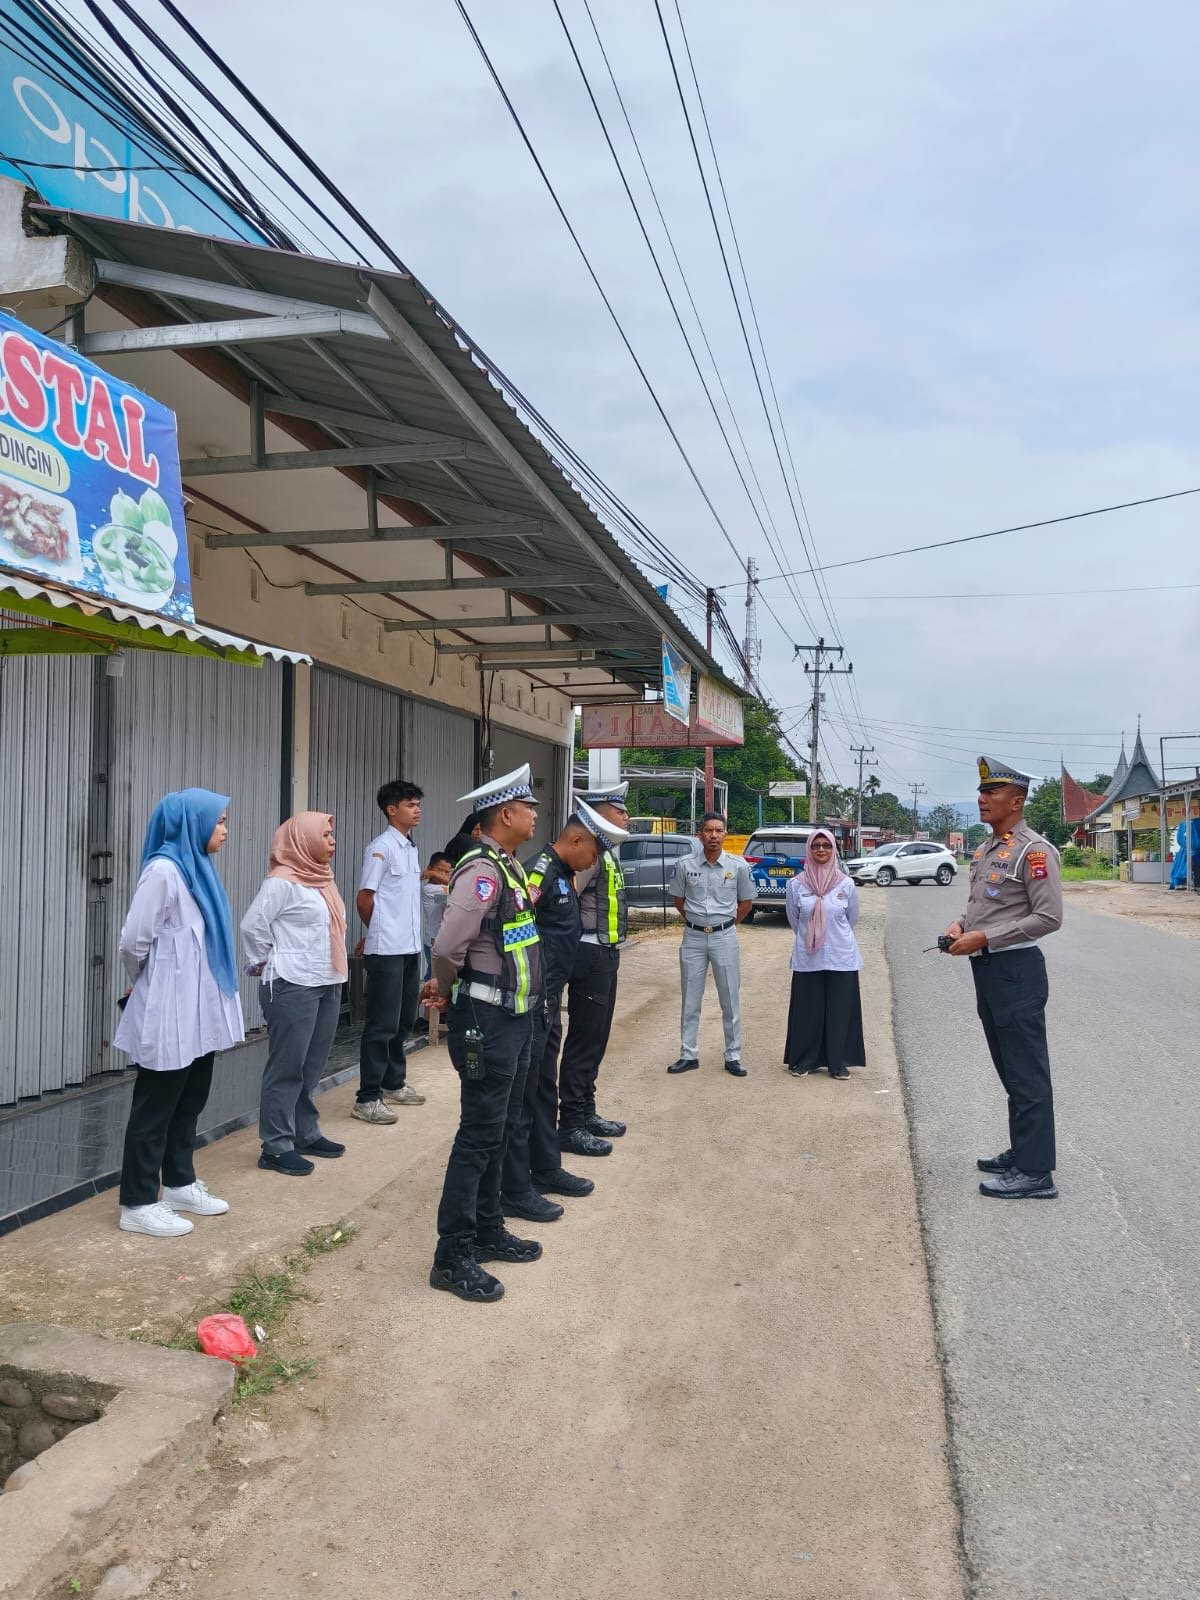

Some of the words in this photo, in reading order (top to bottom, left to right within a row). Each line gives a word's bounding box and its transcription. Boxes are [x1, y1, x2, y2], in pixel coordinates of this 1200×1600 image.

[13, 76, 198, 233] opp
[0, 331, 160, 488] STAL
[991, 861, 1009, 870] POLRI
